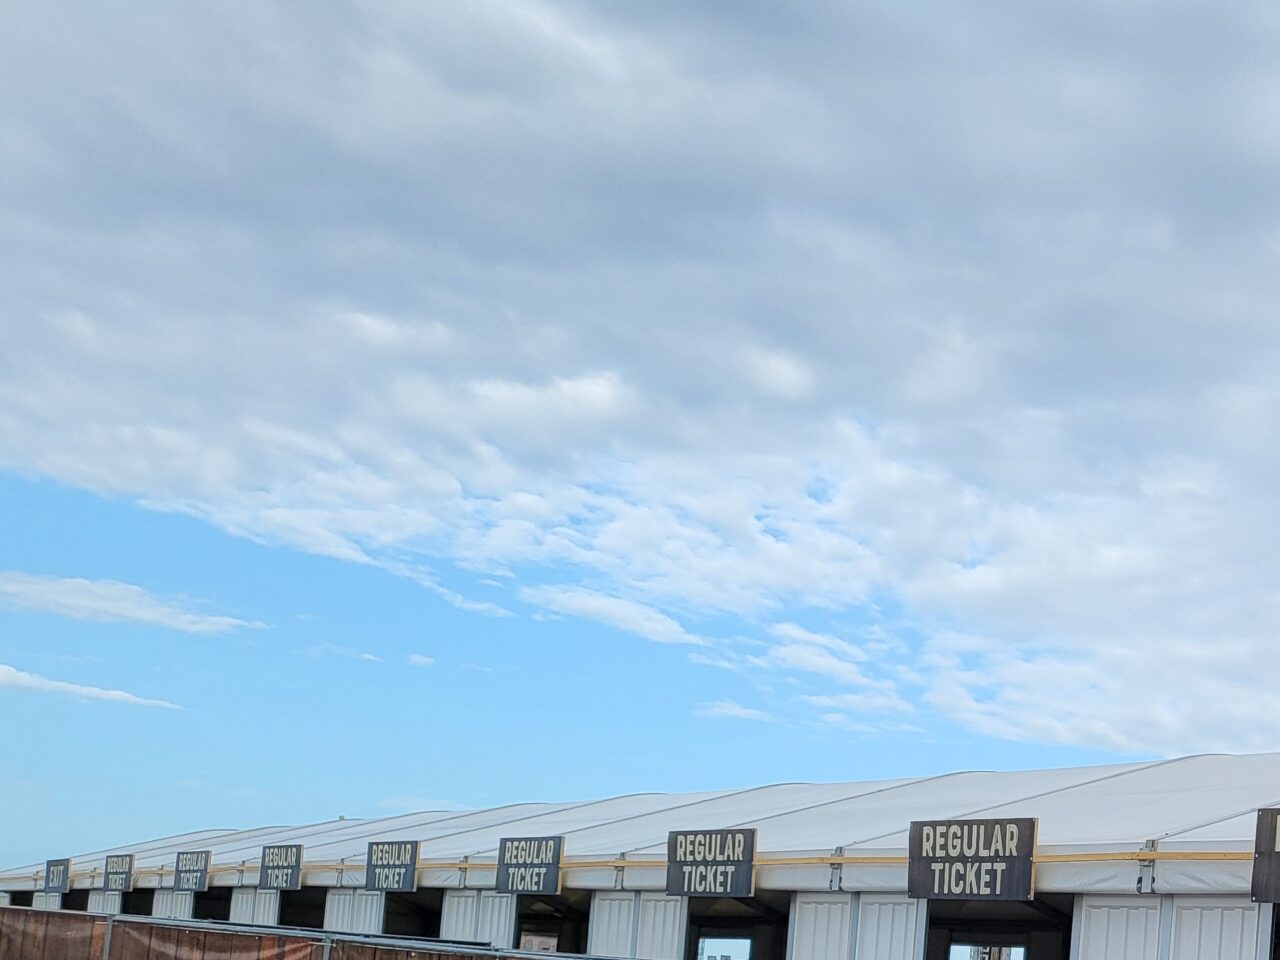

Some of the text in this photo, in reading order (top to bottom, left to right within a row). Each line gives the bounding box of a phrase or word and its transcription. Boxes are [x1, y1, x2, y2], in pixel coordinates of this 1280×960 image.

[676, 833, 745, 861] REGULAR
[922, 824, 1019, 857] REGULAR
[179, 852, 206, 871] REGULAR
[264, 847, 297, 866] REGULAR
[371, 844, 412, 865] REGULAR
[504, 840, 554, 864] REGULAR
[179, 873, 201, 889] TICKET
[267, 869, 292, 888] TICKET
[374, 868, 406, 889] TICKET
[508, 867, 546, 891] TICKET
[682, 865, 735, 893] TICKET
[931, 862, 1006, 895] TICKET
